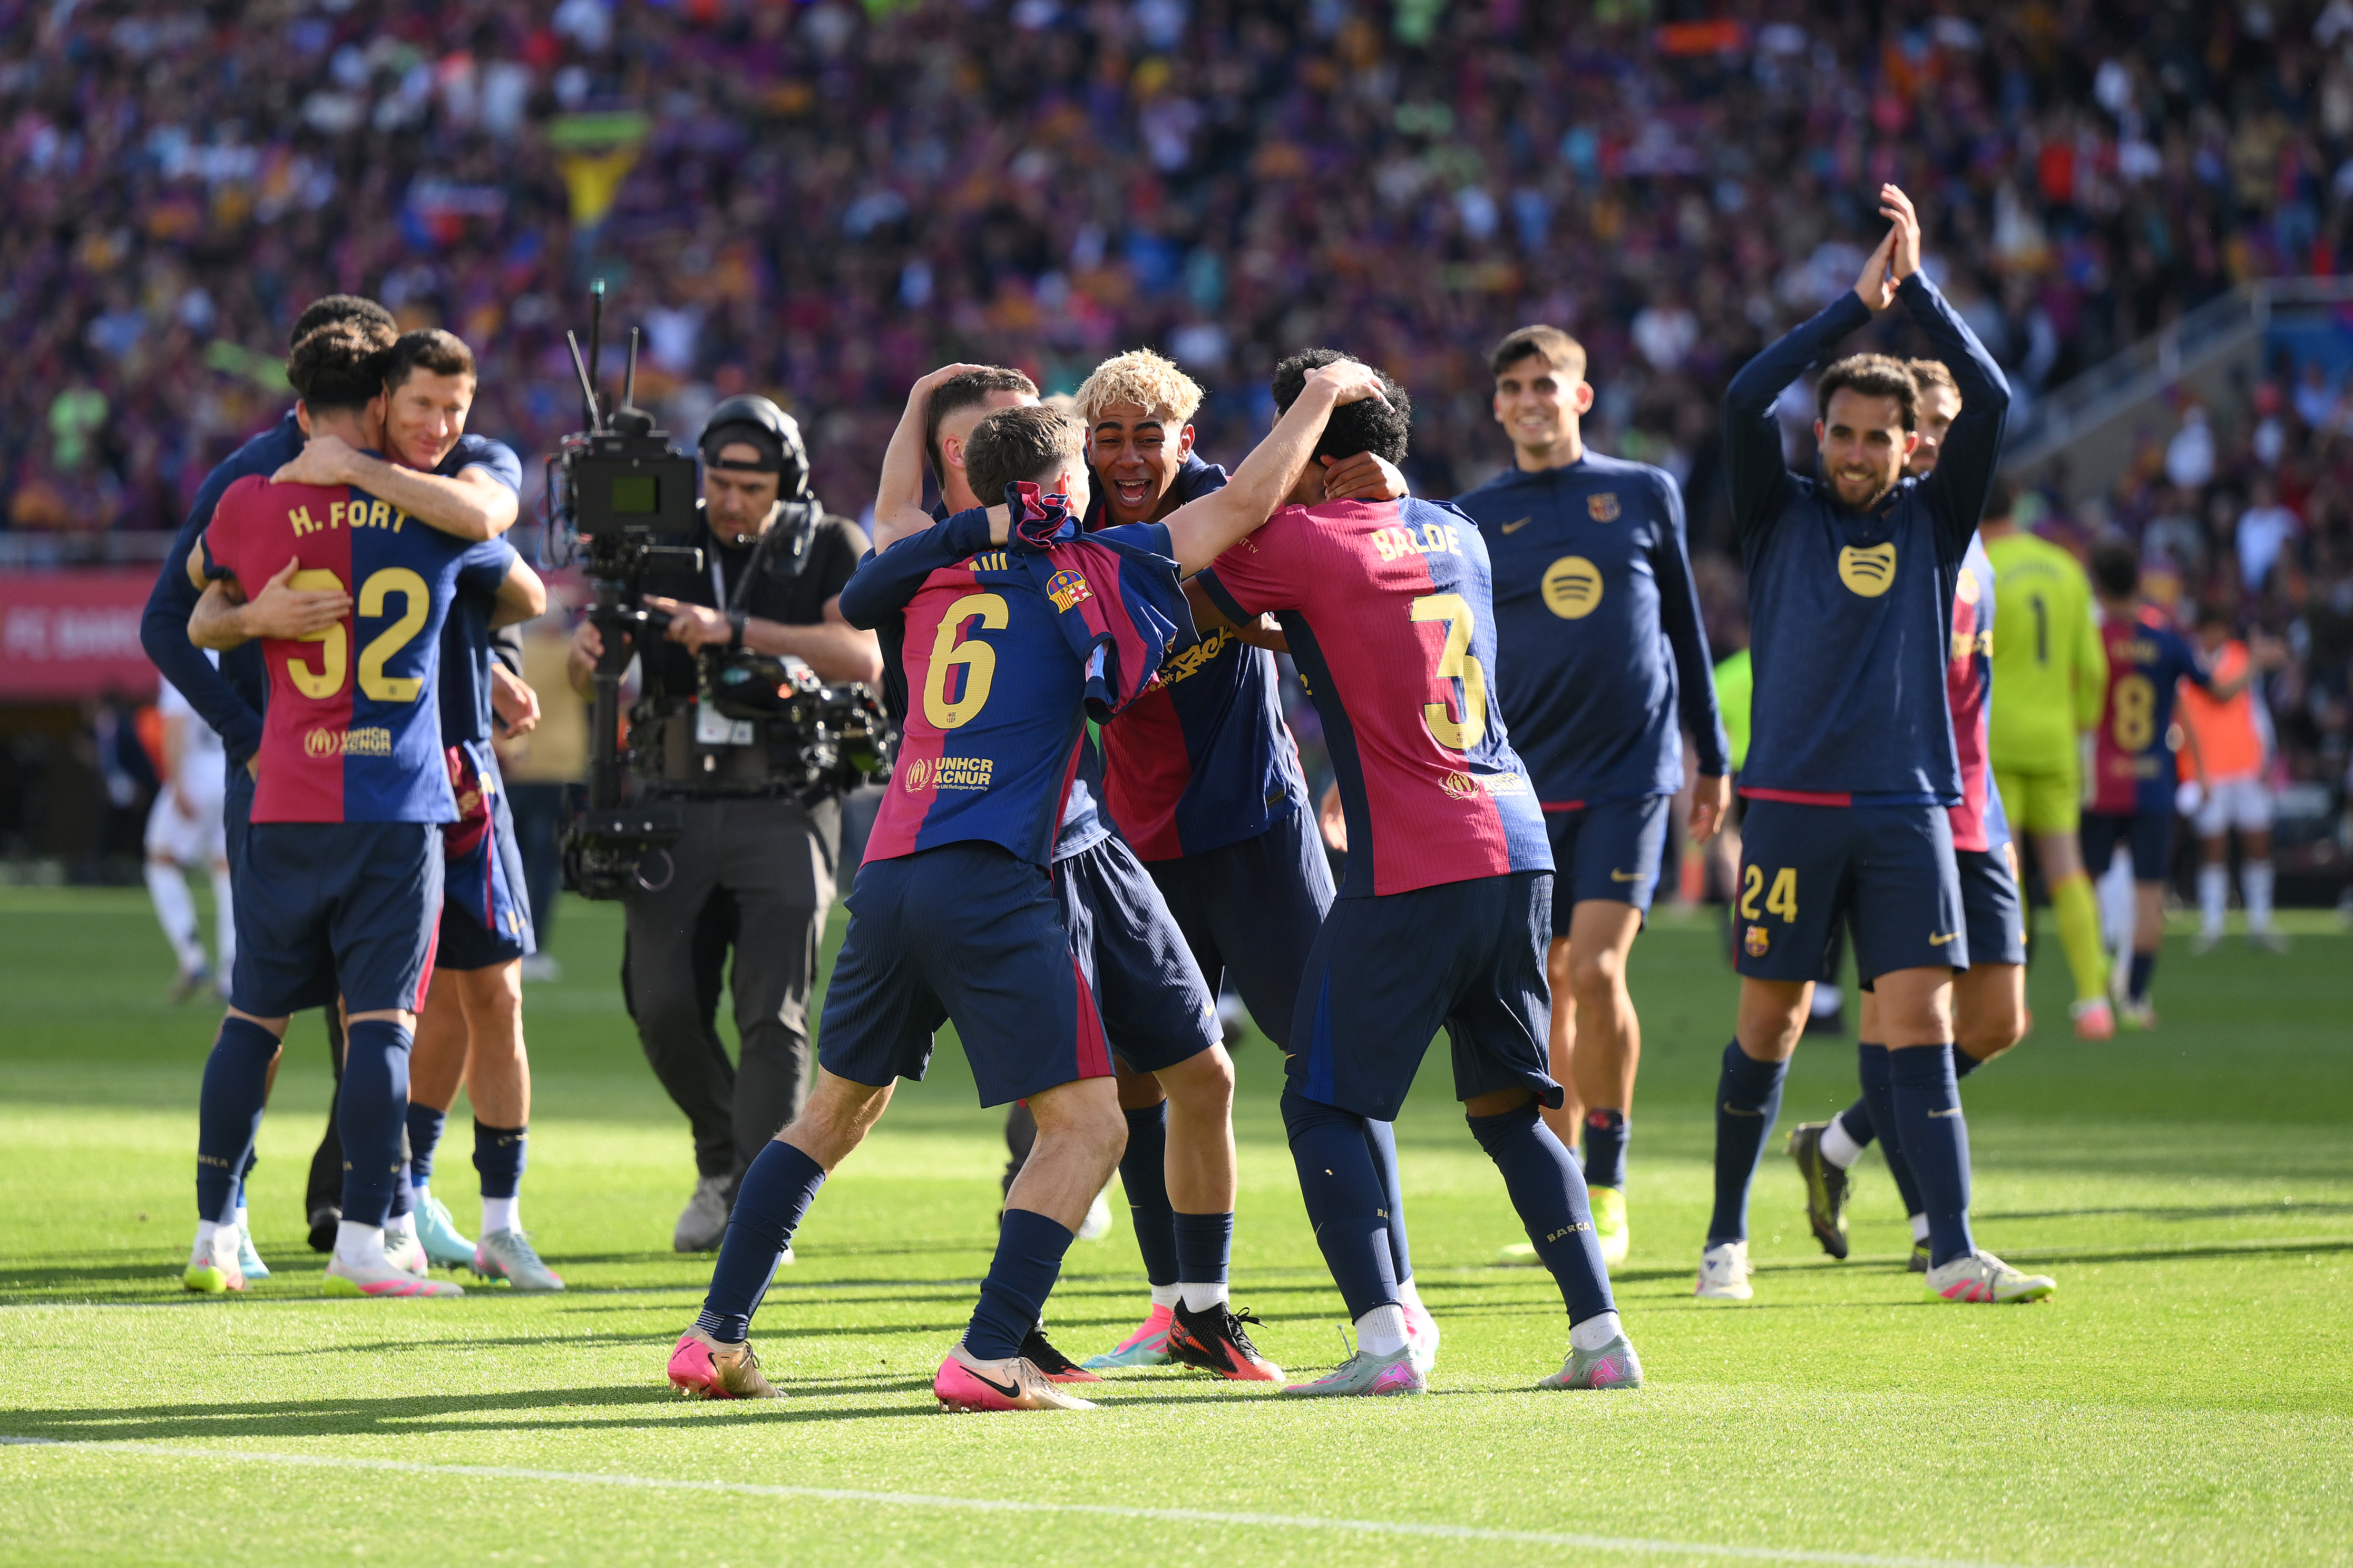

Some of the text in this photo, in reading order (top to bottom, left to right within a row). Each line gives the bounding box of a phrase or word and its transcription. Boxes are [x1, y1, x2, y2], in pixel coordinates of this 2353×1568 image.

[288, 499, 414, 537] H. FORT
[1370, 524, 1463, 563] BALDE
[2029, 593, 2047, 663] 1
[923, 593, 1009, 729] 6
[1409, 593, 1486, 749] 3
[2114, 674, 2155, 751] 8
[932, 771, 991, 785] ACNUR
[935, 757, 993, 772] UNHCR
[1740, 864, 1798, 924] 24
